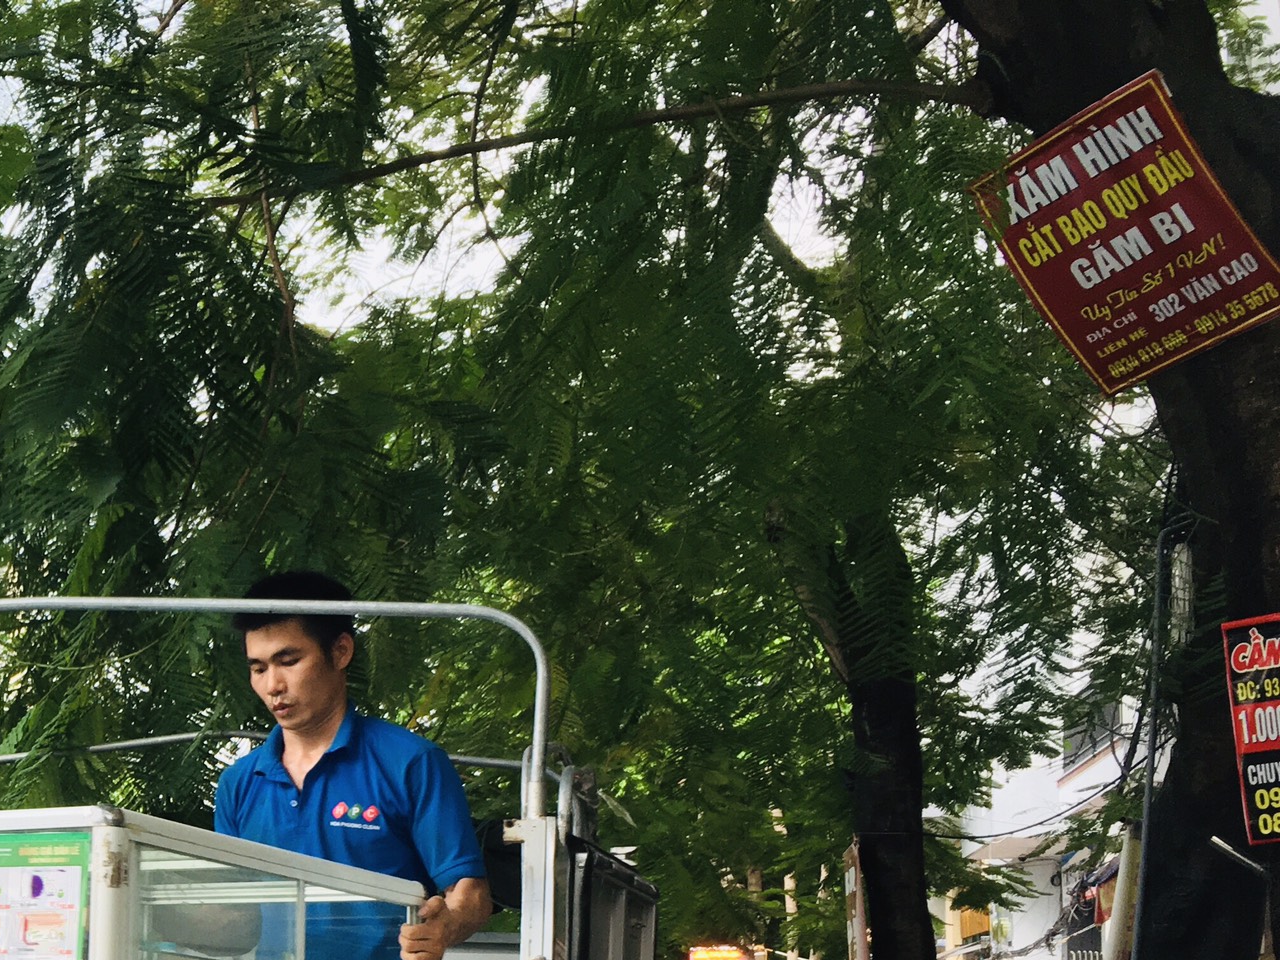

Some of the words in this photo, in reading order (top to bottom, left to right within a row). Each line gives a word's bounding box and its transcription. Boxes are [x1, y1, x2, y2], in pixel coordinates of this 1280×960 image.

[1071, 105, 1164, 178] HÌNH
[1018, 223, 1063, 268] CẮT
[1060, 204, 1108, 246] BAO
[1102, 176, 1150, 221] QUY
[1144, 145, 1195, 197] ĐẦU
[1069, 239, 1154, 290] GĂM
[1150, 203, 1196, 245] BI
[1081, 304, 1112, 321] Uy
[1148, 293, 1186, 322] 302
[1183, 270, 1223, 305] VĂN
[1223, 252, 1259, 287] CAO
[1108, 355, 1141, 378] 0934
[1194, 309, 1228, 335] 0914
[1225, 298, 1246, 318] 35
[1243, 281, 1280, 312] 5678
[1237, 681, 1261, 701] ĐC:
